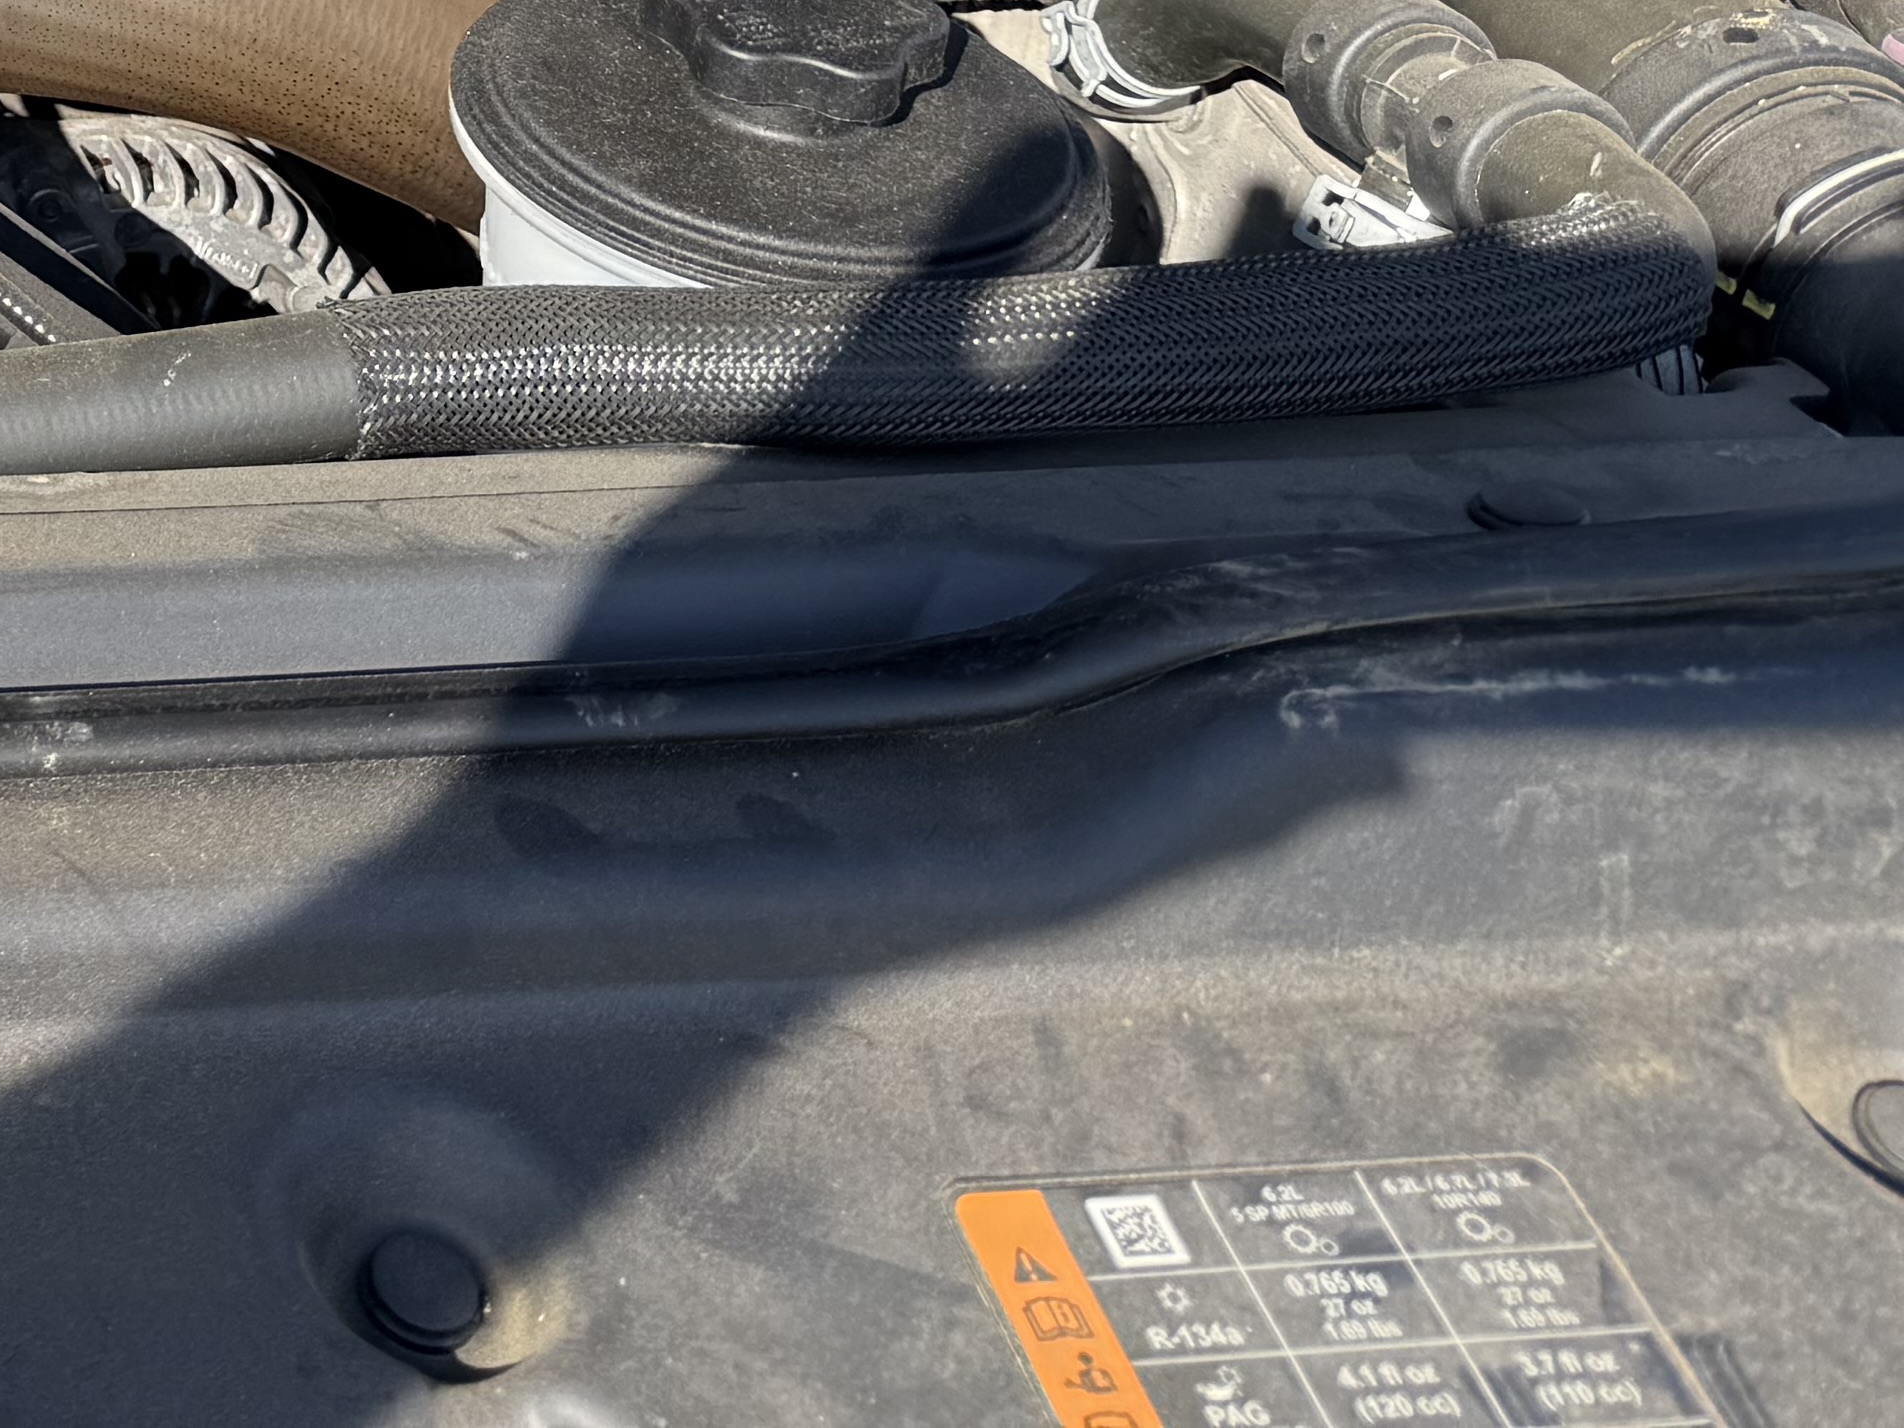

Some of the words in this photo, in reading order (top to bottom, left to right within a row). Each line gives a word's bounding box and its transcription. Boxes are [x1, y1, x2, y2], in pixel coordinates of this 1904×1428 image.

[1261, 1185, 1305, 1203] 6.2L
[1244, 1205, 1270, 1222] SP
[1283, 1270, 1352, 1297] 0.765
[1349, 1269, 1389, 1297] kg
[1460, 1258, 1528, 1286] 0.765
[1524, 1256, 1566, 1286] kg
[1320, 1297, 1346, 1318] 27
[1350, 1298, 1379, 1316] oz
[1527, 1286, 1556, 1304] oz
[1146, 1321, 1246, 1350] R-134a
[1322, 1318, 1368, 1341] 1.69
[1366, 1318, 1404, 1338] lbs
[1337, 1362, 1378, 1389] 4.1
[1404, 1362, 1441, 1385] oz
[1514, 1349, 1556, 1377] 3.7
[1583, 1350, 1621, 1373] oz
[1353, 1392, 1415, 1425] (120
[1415, 1390, 1462, 1418] cc)
[1536, 1379, 1596, 1411] (110
[1204, 1399, 1271, 1428] PAG
